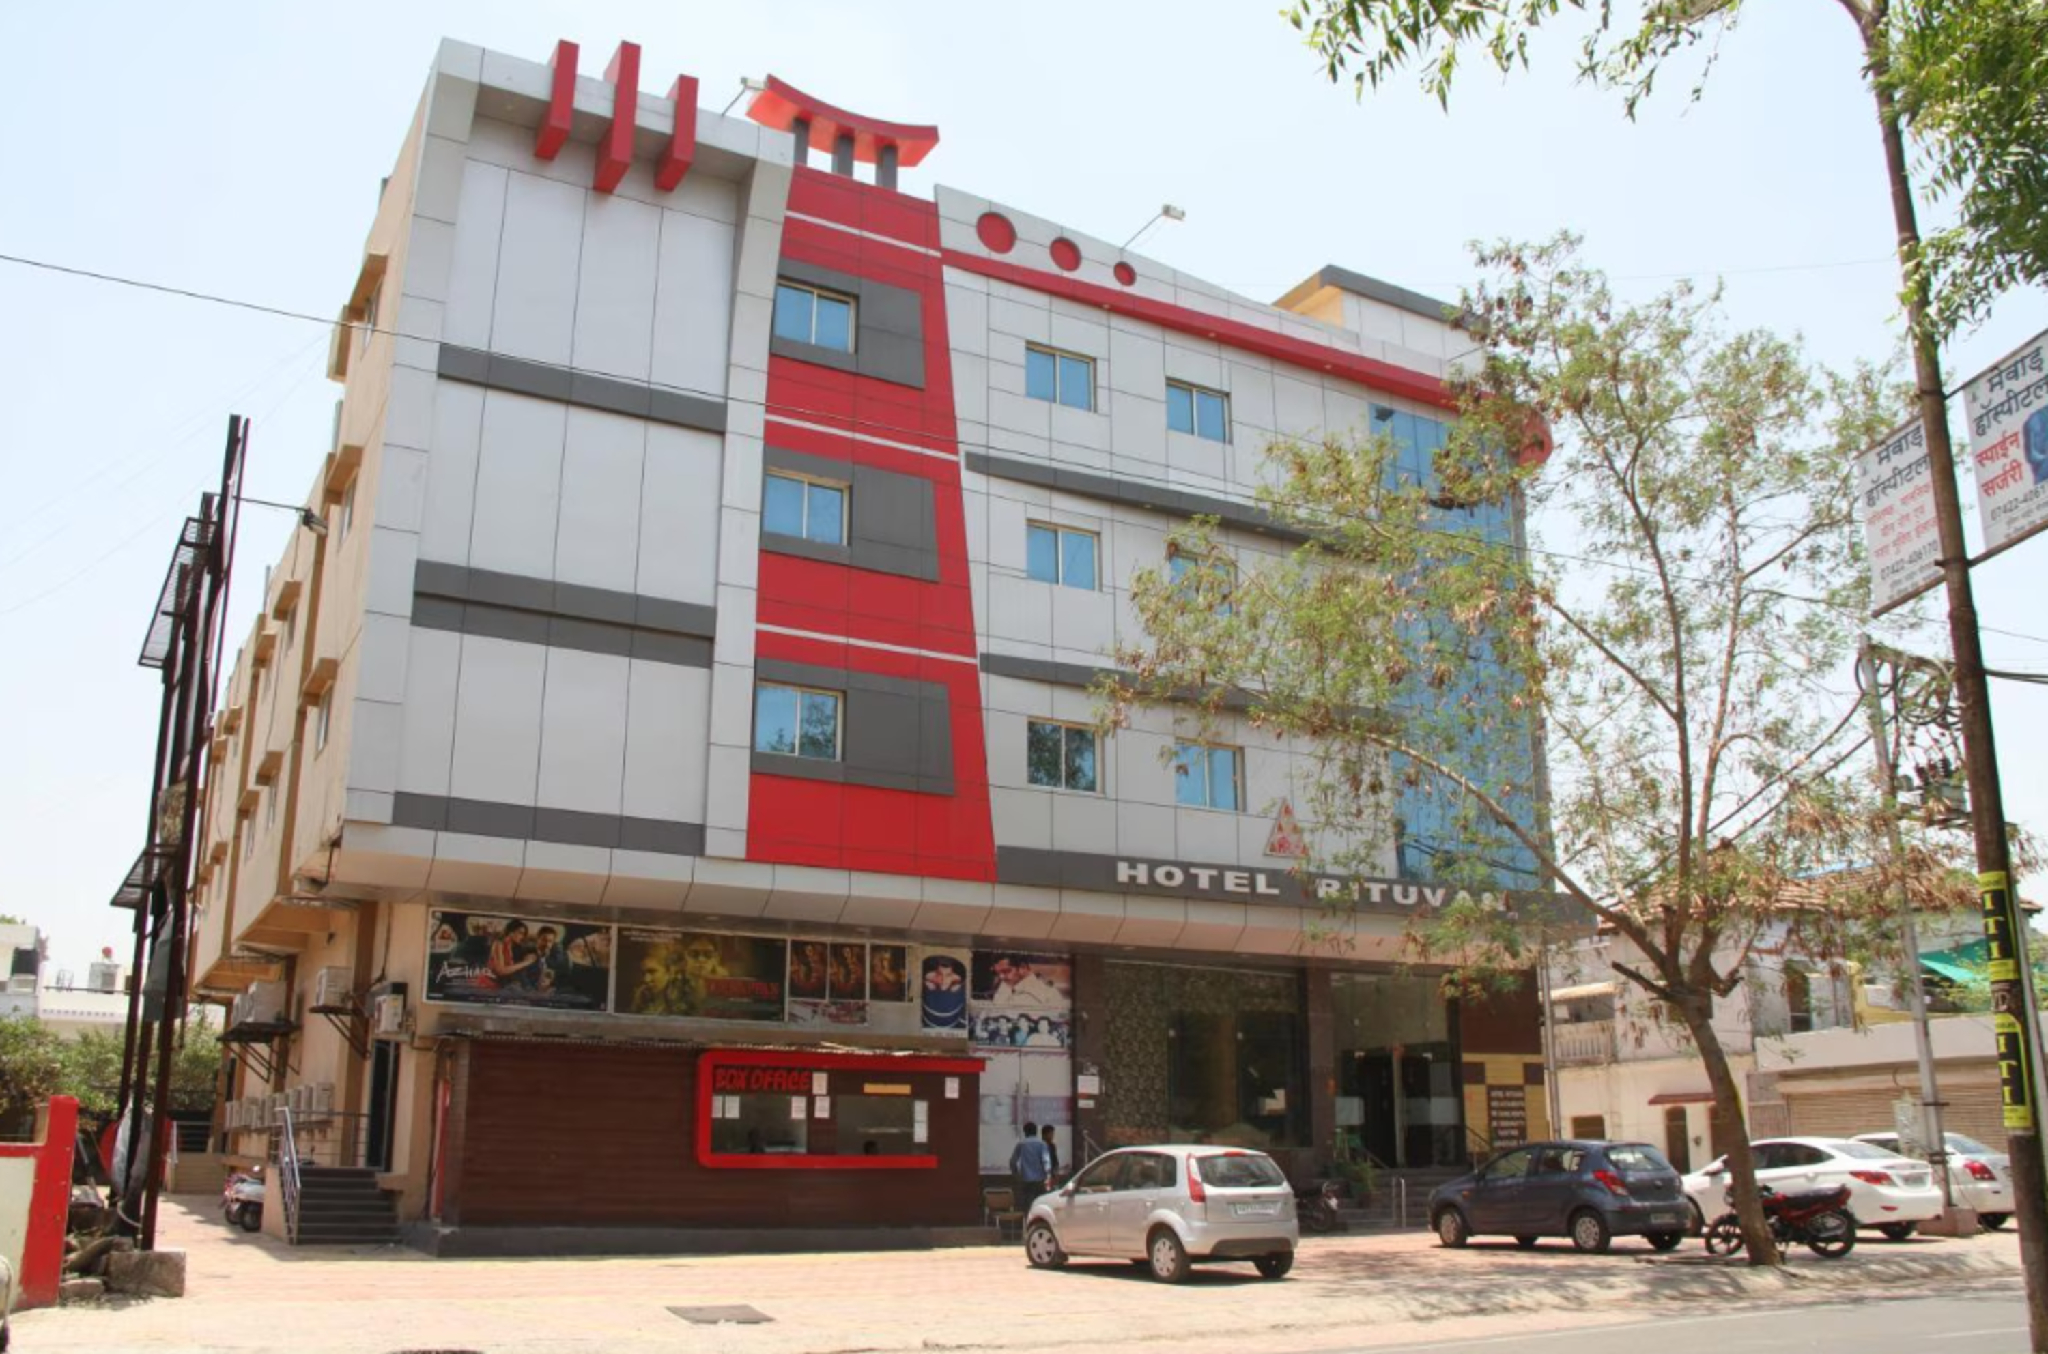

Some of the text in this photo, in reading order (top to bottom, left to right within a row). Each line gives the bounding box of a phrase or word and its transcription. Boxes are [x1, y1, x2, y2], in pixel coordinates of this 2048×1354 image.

[1976, 430, 2021, 468] स्पाईन
[1981, 459, 2024, 498] सर्जरी
[1117, 861, 1280, 896] HOTEL
[715, 1067, 811, 1091] BOX OFFICE
